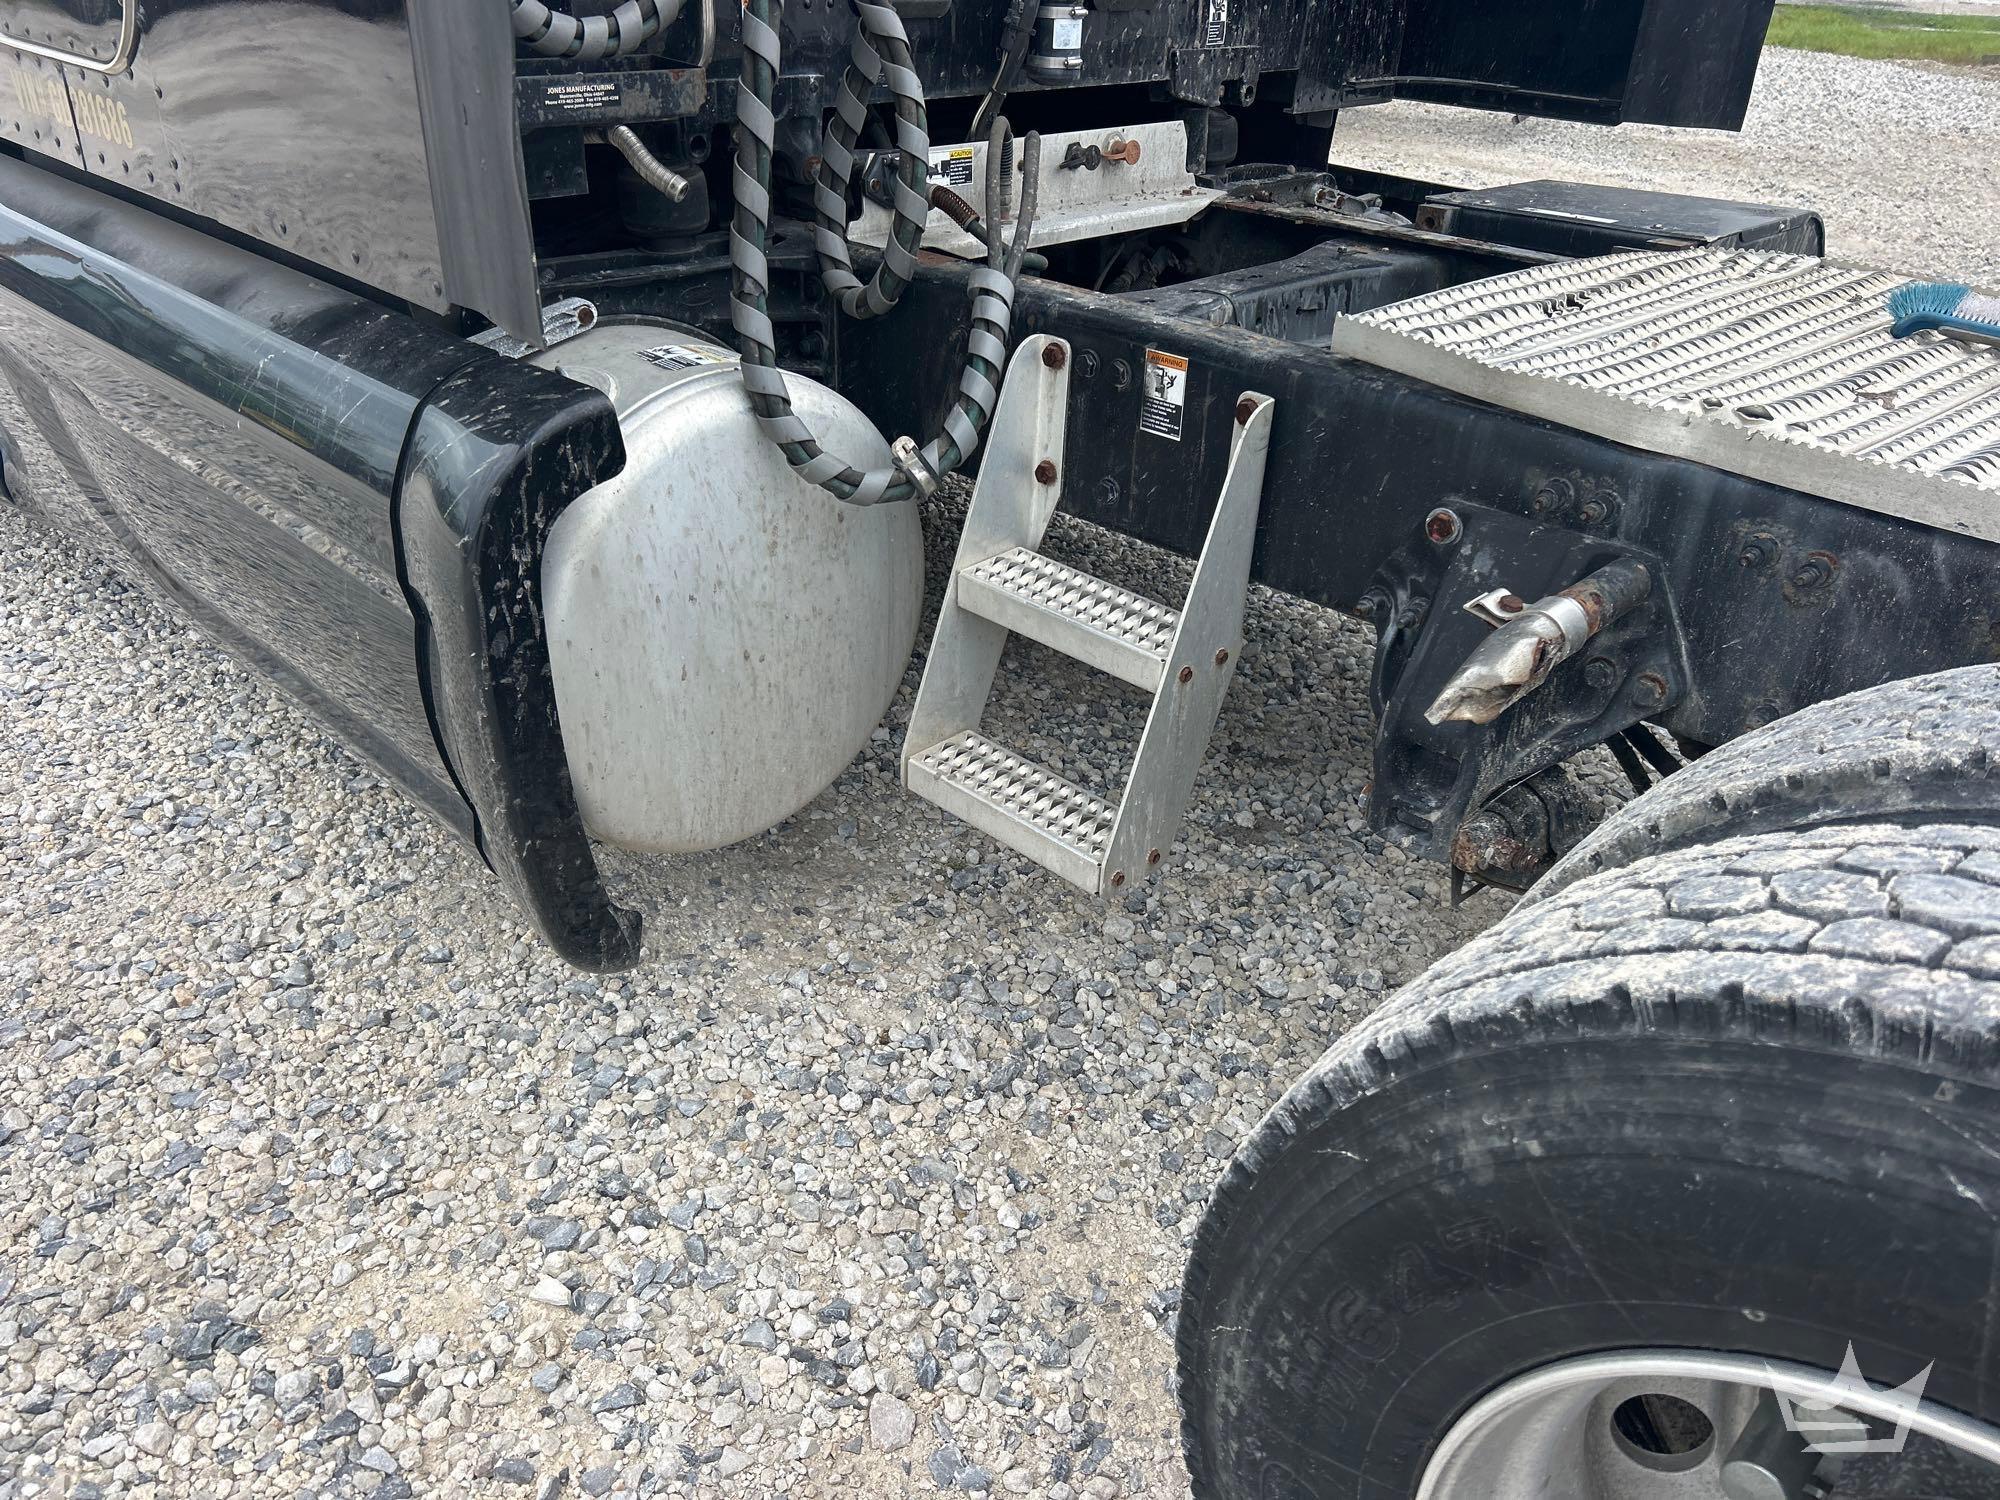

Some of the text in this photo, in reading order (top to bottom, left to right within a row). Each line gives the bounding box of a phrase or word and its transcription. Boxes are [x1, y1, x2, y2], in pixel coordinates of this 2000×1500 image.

[547, 84, 615, 95] JONES MANUFACTURING
[1155, 355, 1182, 368] WARNING
